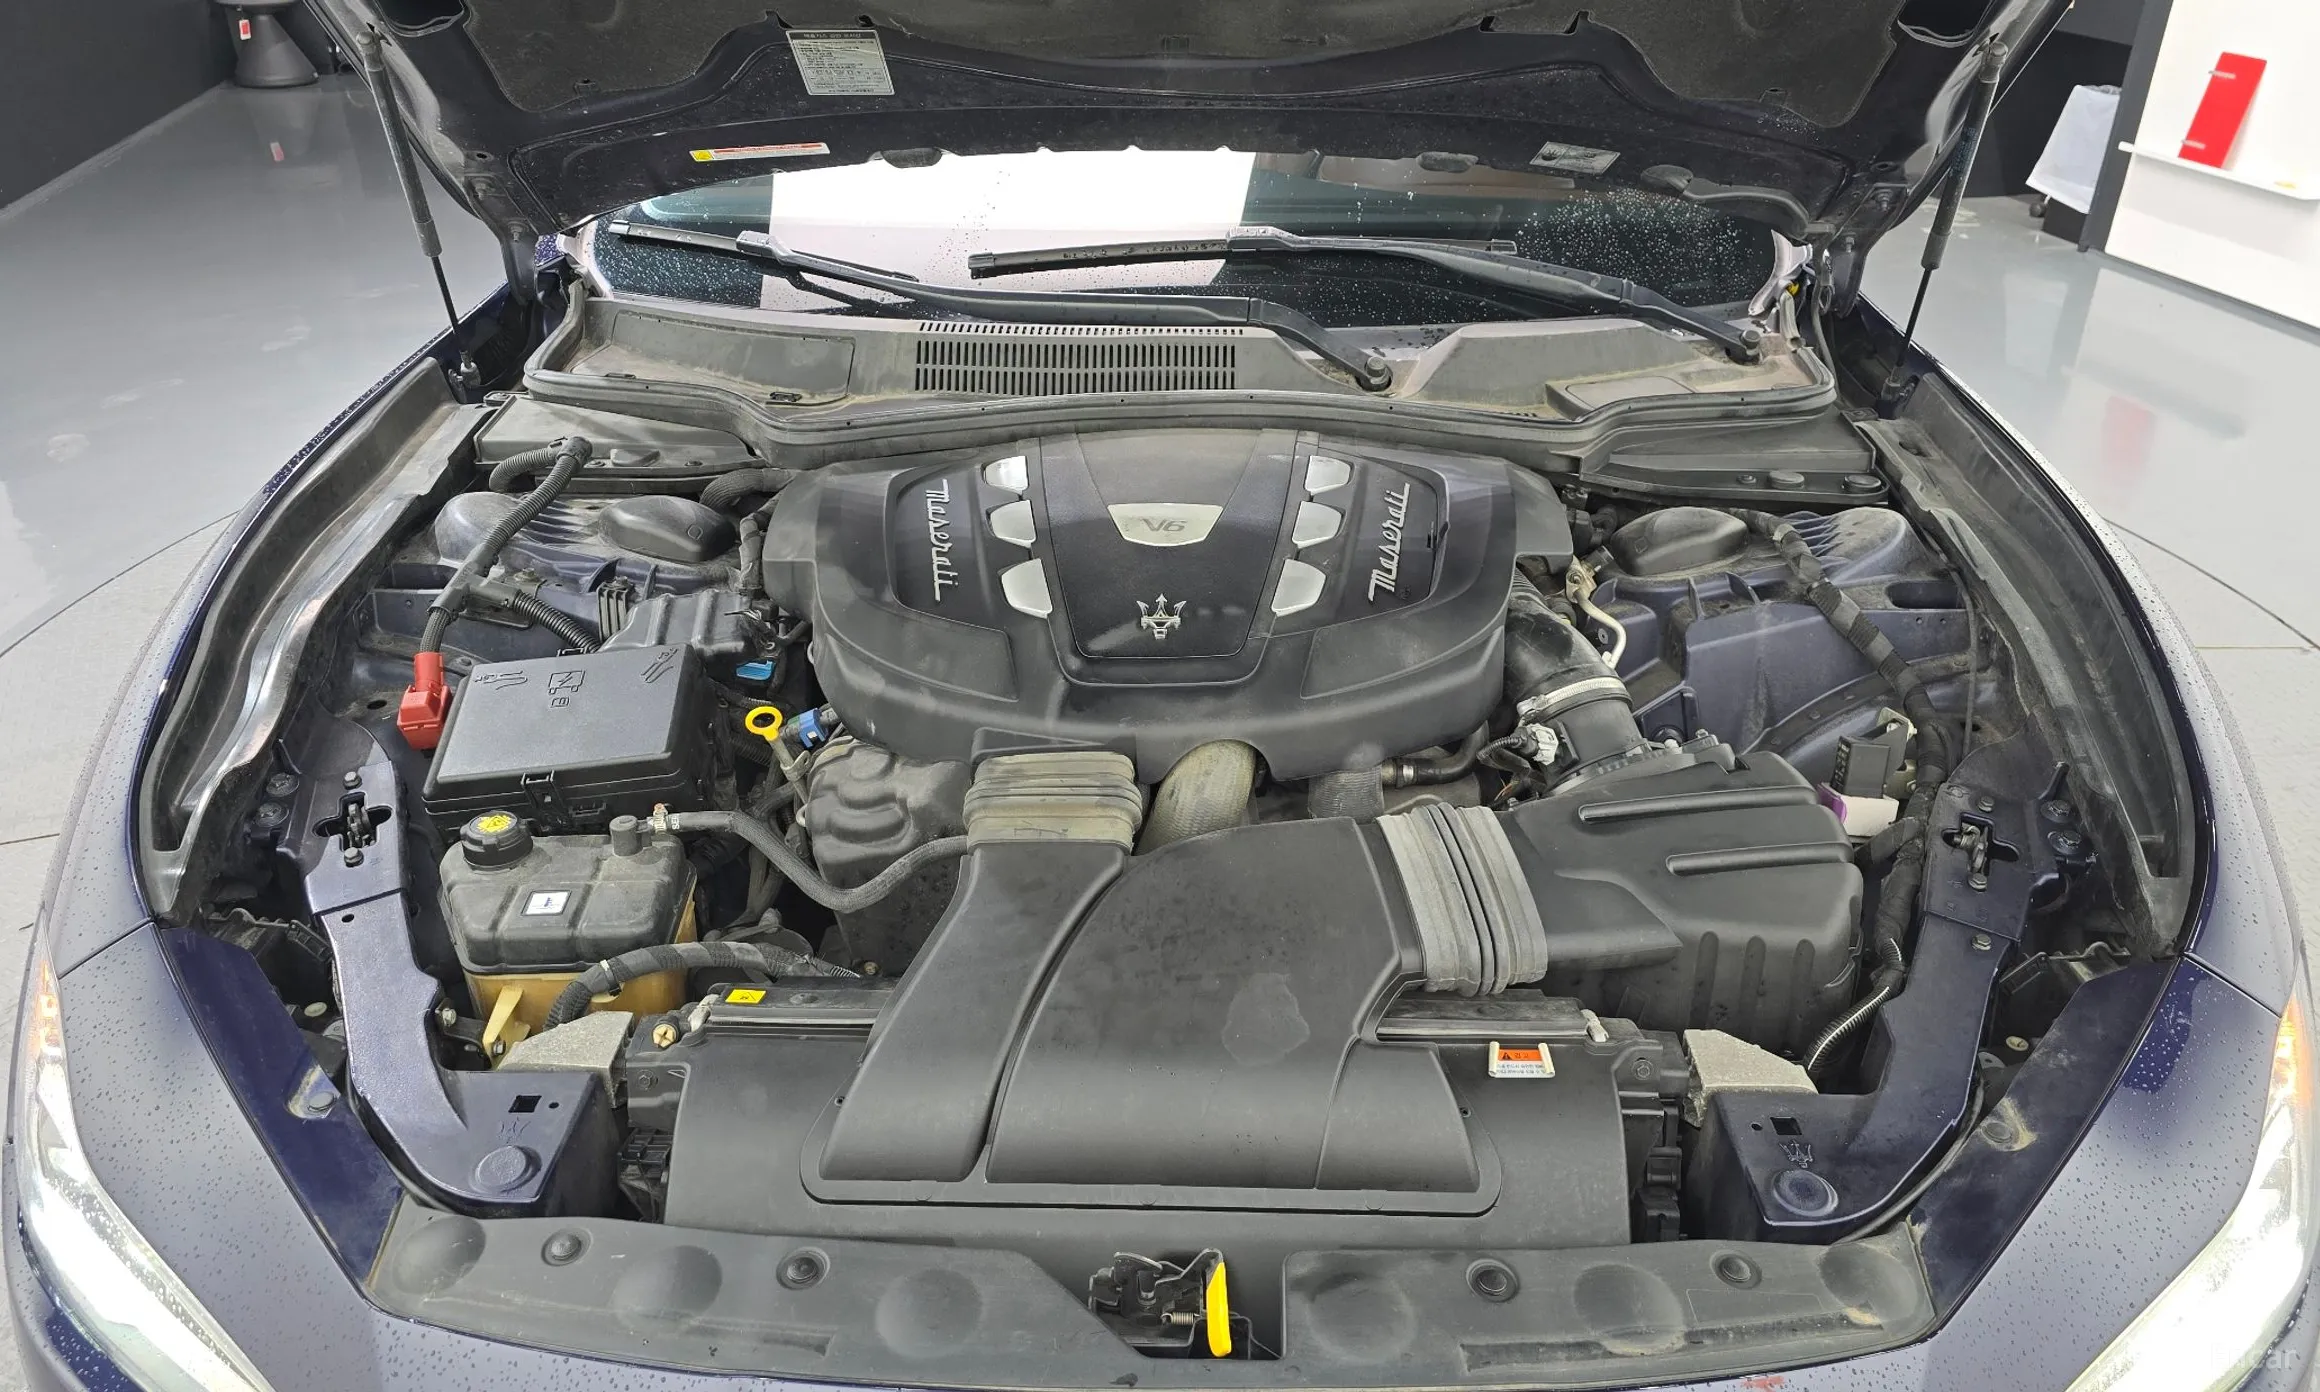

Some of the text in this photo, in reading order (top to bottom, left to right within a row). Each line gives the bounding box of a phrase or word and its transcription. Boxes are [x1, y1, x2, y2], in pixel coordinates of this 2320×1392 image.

[925, 478, 959, 602] Maserati
[1141, 518, 1188, 532] V6
[1368, 482, 1411, 602] Maserati
